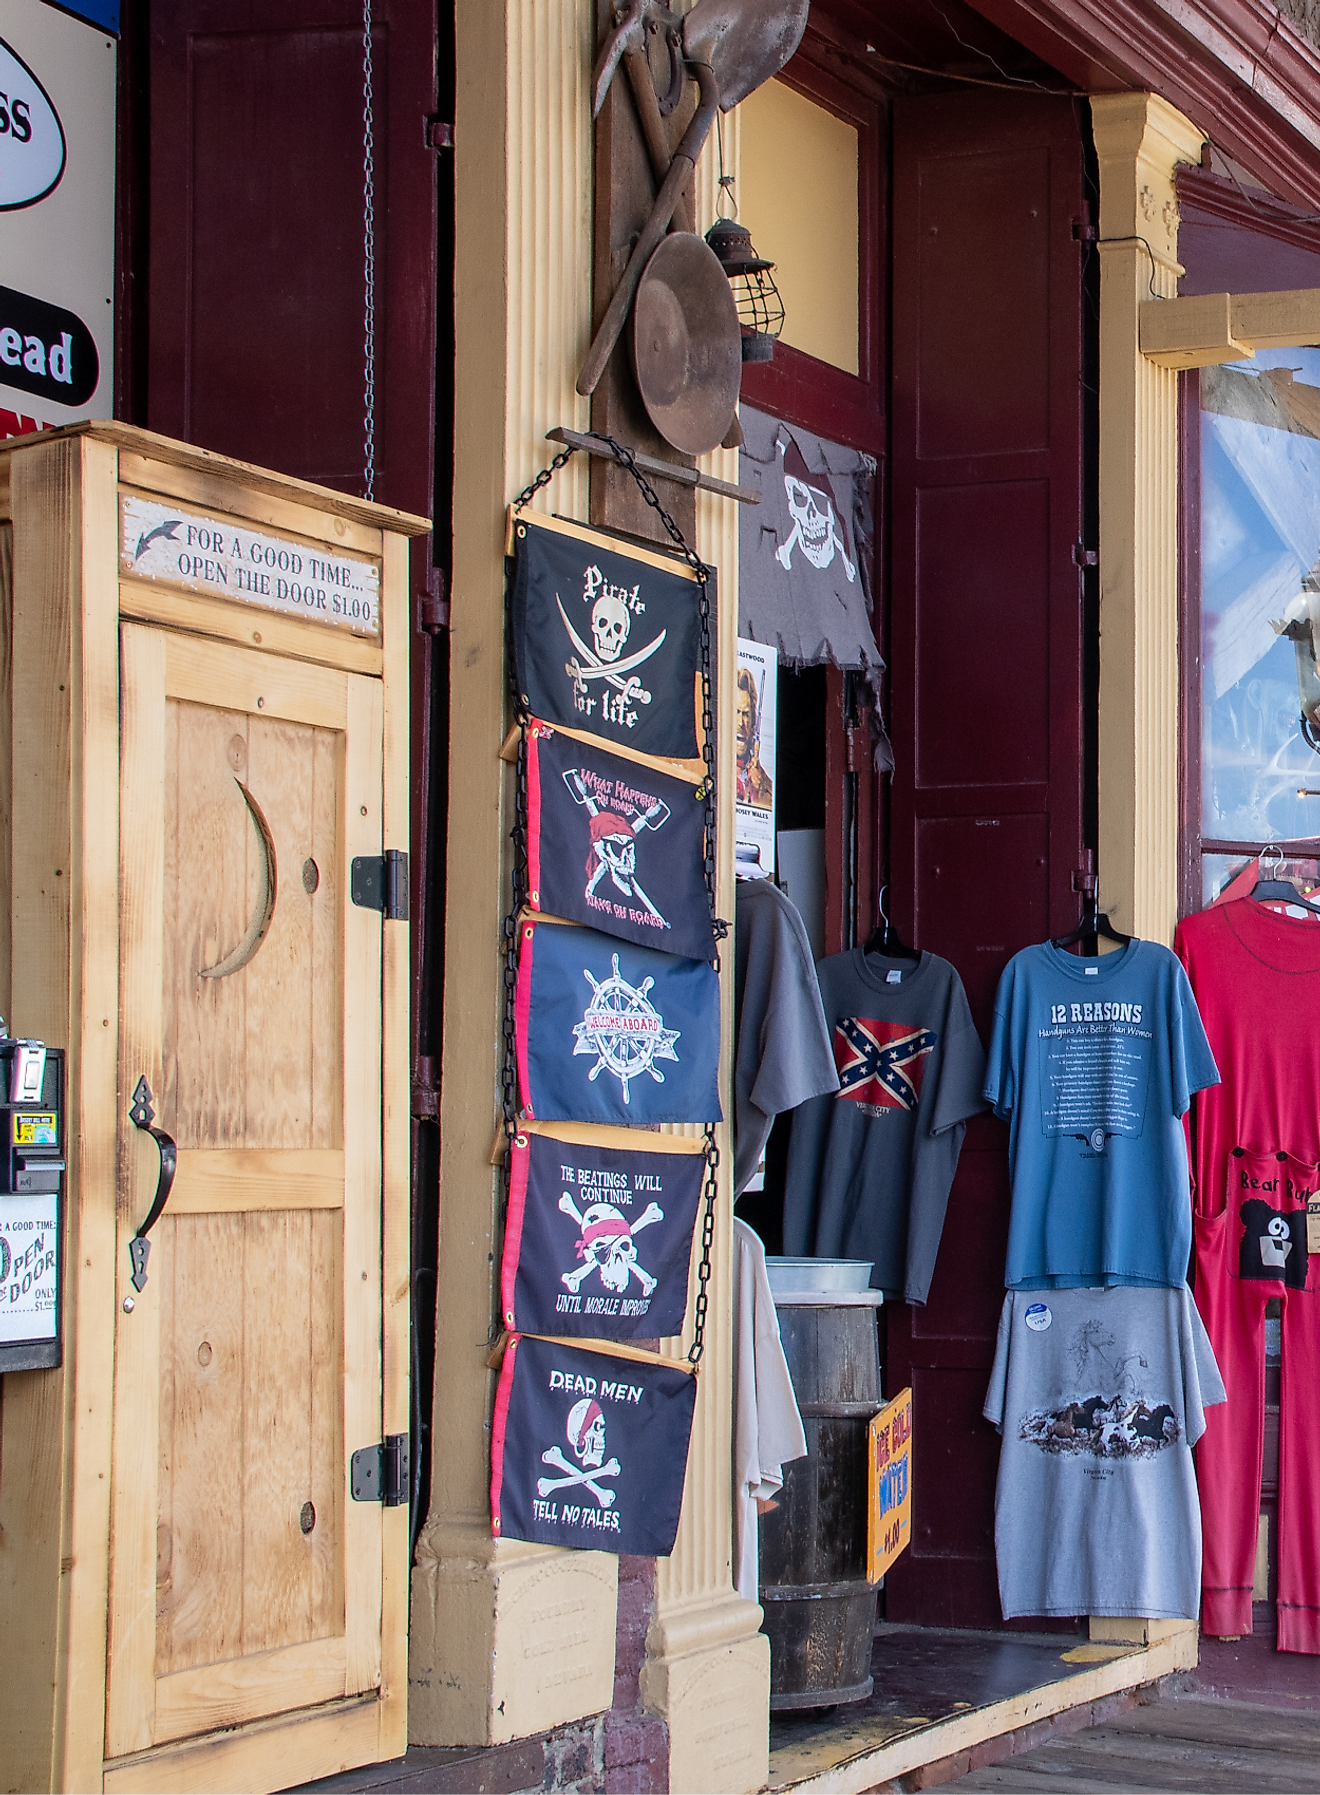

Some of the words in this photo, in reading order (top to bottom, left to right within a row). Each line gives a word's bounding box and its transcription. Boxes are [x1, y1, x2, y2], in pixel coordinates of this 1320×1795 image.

[186, 524, 224, 554] FOR
[231, 538, 243, 559] A
[250, 543, 303, 574] GOOD
[178, 553, 229, 584] OPEN
[234, 568, 270, 595] THE
[276, 578, 327, 609] DOOR
[332, 593, 372, 621] $1.00
[582, 564, 646, 615] Pirate
[602, 689, 640, 729] life
[589, 1016, 620, 1030] WELCOME
[623, 1018, 658, 1032] ABOARD
[1051, 1004, 1067, 1025] 12
[1070, 1002, 1143, 1024] REASONS
[1076, 1024, 1089, 1035] Are
[1108, 1022, 1126, 1034] Than
[560, 1165, 575, 1183] THE
[577, 1169, 628, 1189] BEATINGS
[634, 1174, 663, 1191] WILL
[1241, 1169, 1280, 1192] Bear
[580, 1186, 633, 1205] CONTINUE
[5, 1222, 10, 1231] A
[12, 1221, 34, 1231] GOOD
[10, 1249, 55, 1303] DOOR
[555, 1294, 582, 1314] UNTIL
[584, 1296, 620, 1315] MORALE
[548, 1370, 597, 1395] DEAD
[600, 1380, 645, 1404] MEN
[876, 1422, 890, 1473] ICE
[533, 1499, 558, 1523] TELL
[561, 1504, 580, 1527] NO
[581, 1508, 622, 1533] TALES
